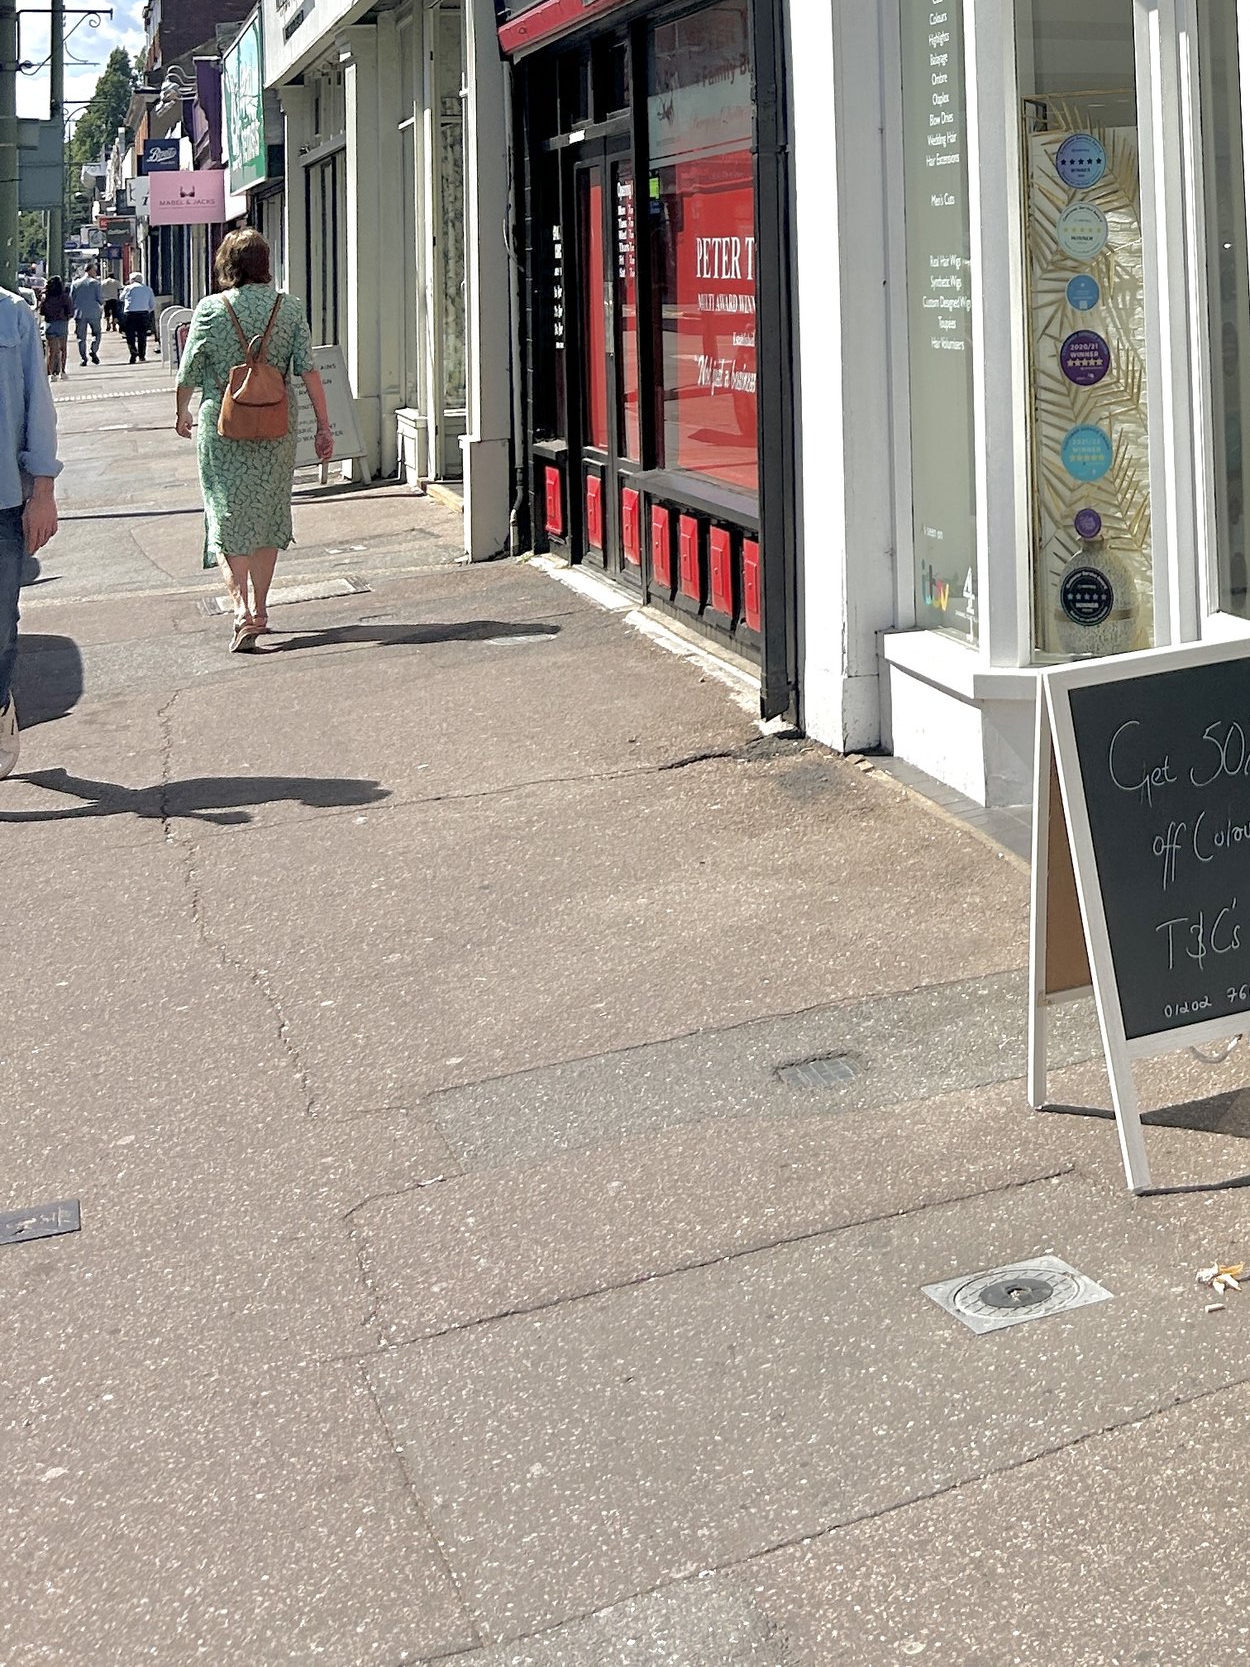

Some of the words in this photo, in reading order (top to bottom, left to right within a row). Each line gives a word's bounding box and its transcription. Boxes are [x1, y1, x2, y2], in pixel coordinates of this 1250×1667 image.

[696, 236, 741, 280] PETER
[716, 294, 737, 313] AWARD
[1109, 720, 1178, 808] Get
[1153, 821, 1187, 891] off
[1164, 996, 1212, 1018] 01202
